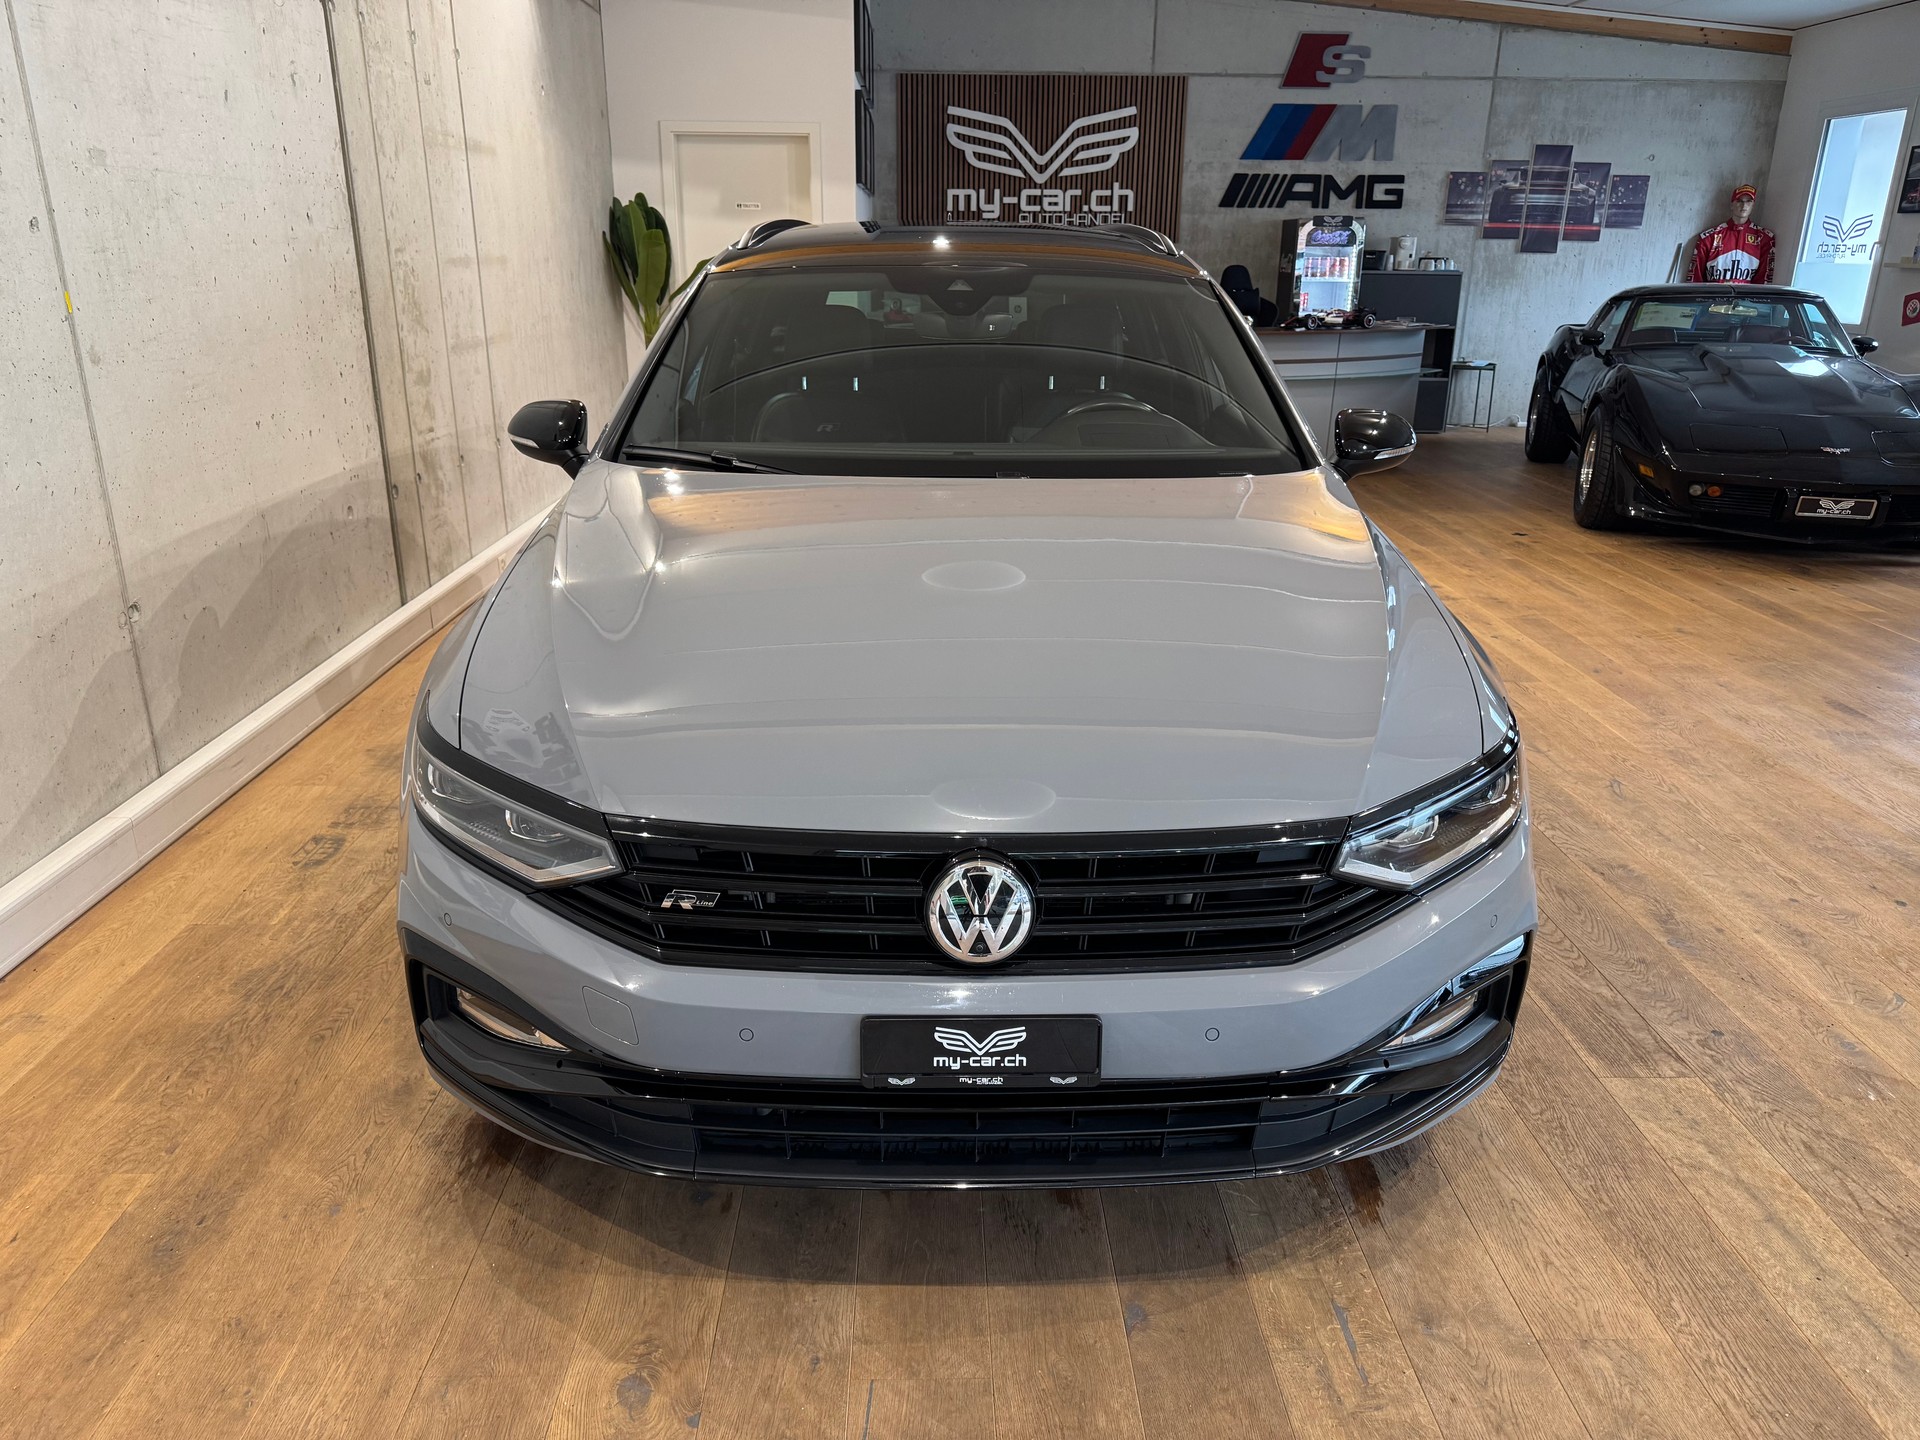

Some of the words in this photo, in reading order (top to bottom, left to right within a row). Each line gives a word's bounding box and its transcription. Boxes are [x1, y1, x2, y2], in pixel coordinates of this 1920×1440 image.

[1315, 45, 1371, 84] S
[1304, 104, 1398, 162] M
[946, 182, 1134, 219] my-car.ch
[1276, 174, 1405, 209] AMG
[936, 864, 1026, 960] VW
[933, 1053, 1027, 1070] my-car.ch
[959, 1076, 1004, 1084] my-car.ch
